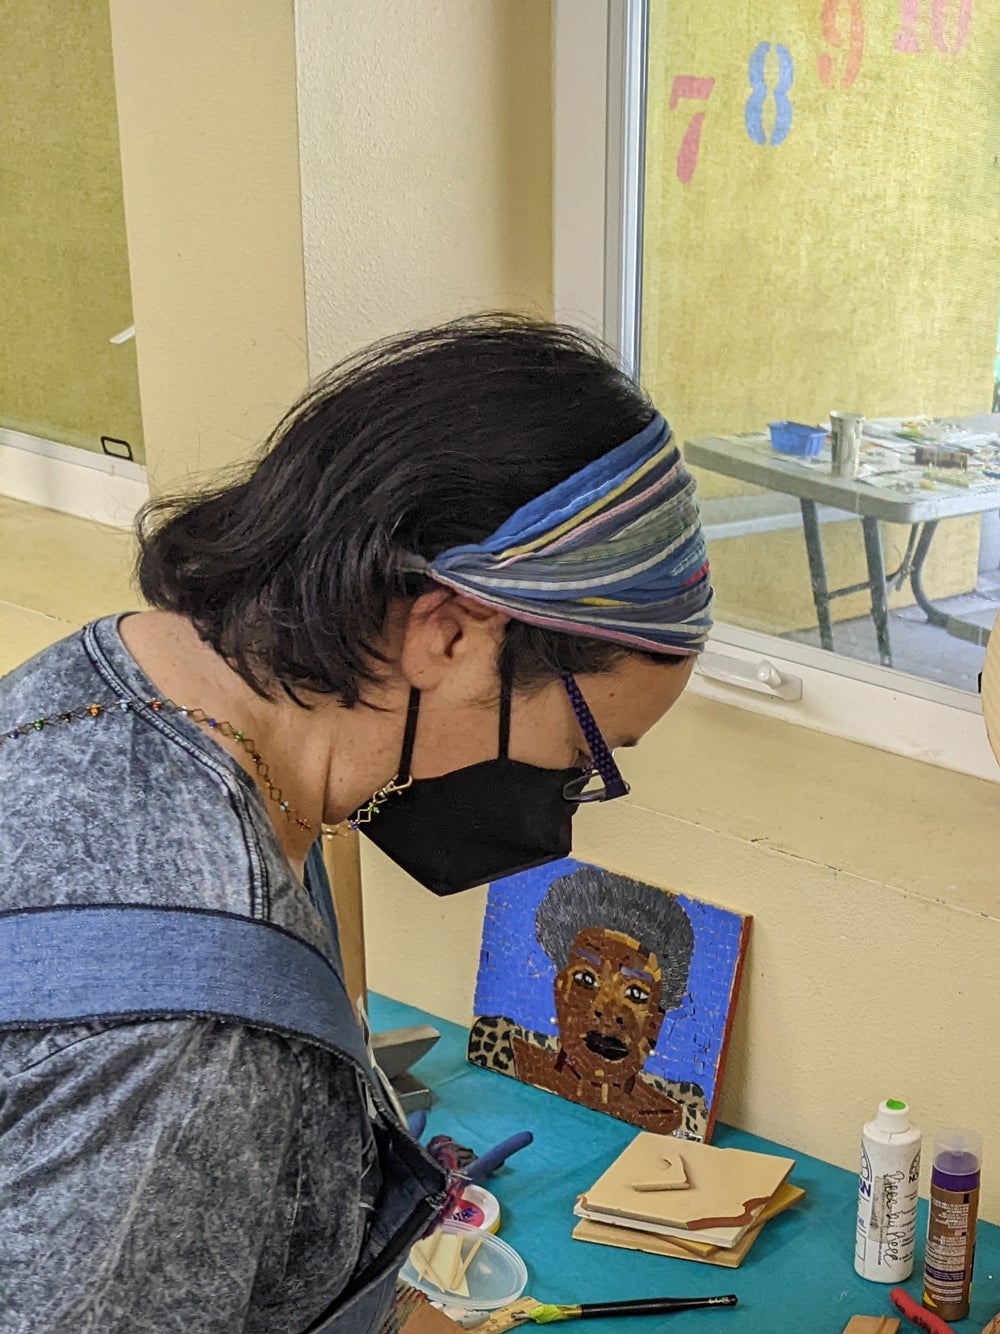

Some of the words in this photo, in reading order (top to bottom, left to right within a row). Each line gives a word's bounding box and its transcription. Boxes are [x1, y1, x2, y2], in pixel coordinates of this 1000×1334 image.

[669, 75, 715, 184] 7
[744, 40, 794, 147] 8
[817, 0, 865, 90] 9
